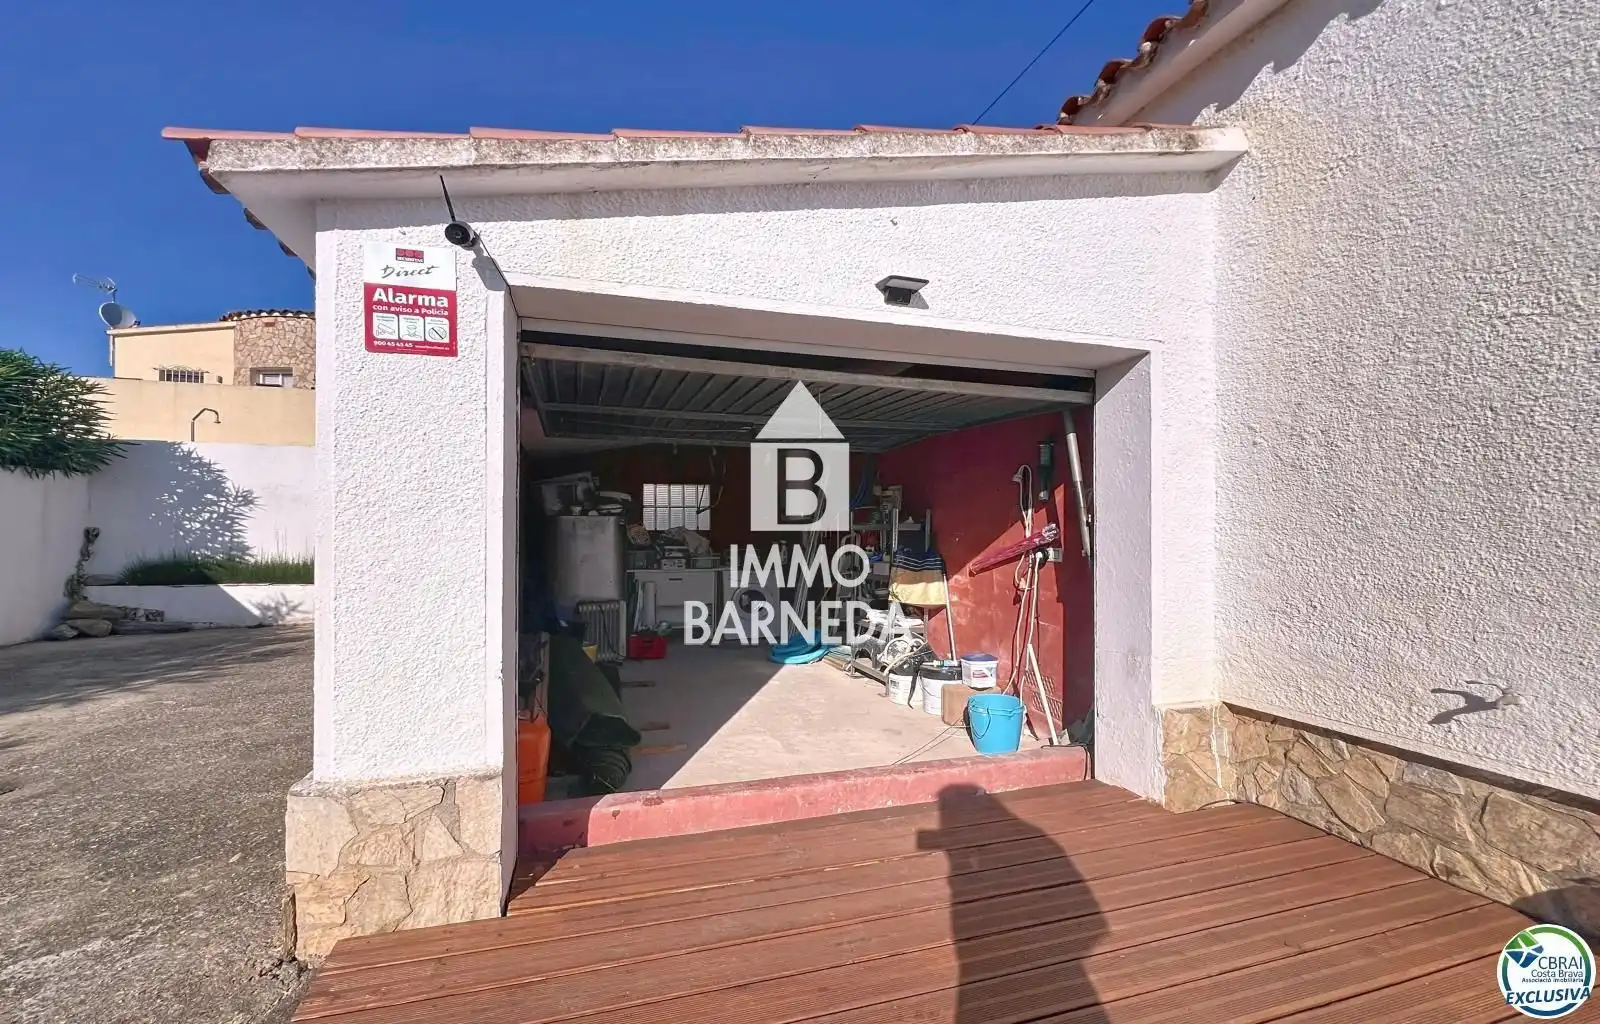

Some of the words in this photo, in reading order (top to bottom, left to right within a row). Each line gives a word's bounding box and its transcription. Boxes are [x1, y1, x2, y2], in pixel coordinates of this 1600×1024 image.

[380, 264, 440, 279] Direct
[372, 287, 449, 308] Alarma
[390, 305, 413, 313] aviso
